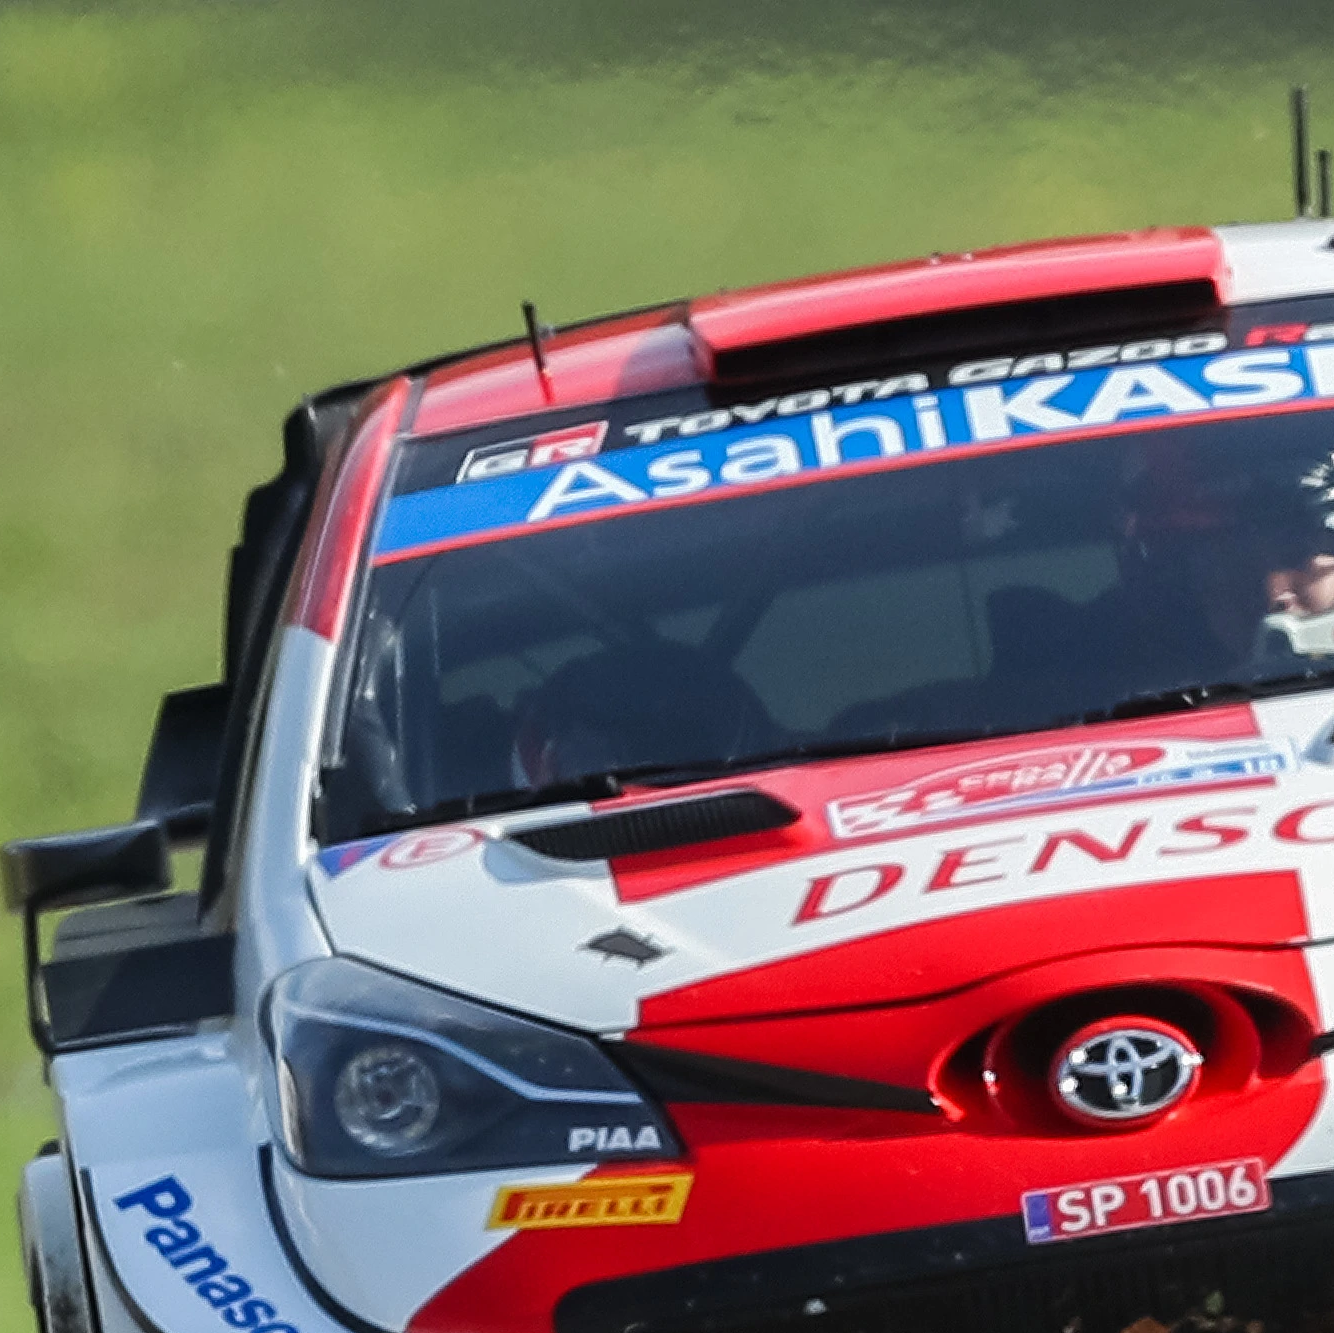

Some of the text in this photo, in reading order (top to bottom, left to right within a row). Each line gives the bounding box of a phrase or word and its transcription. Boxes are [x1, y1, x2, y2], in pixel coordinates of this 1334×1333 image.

[624, 373, 929, 441] TOYOTA
[947, 333, 1228, 386] GAZOO
[464, 434, 603, 482] GR
[569, 1125, 663, 1152] PIAA
[499, 1180, 675, 1223] PIRELLI
[1057, 1166, 1257, 1233] SP 1006
